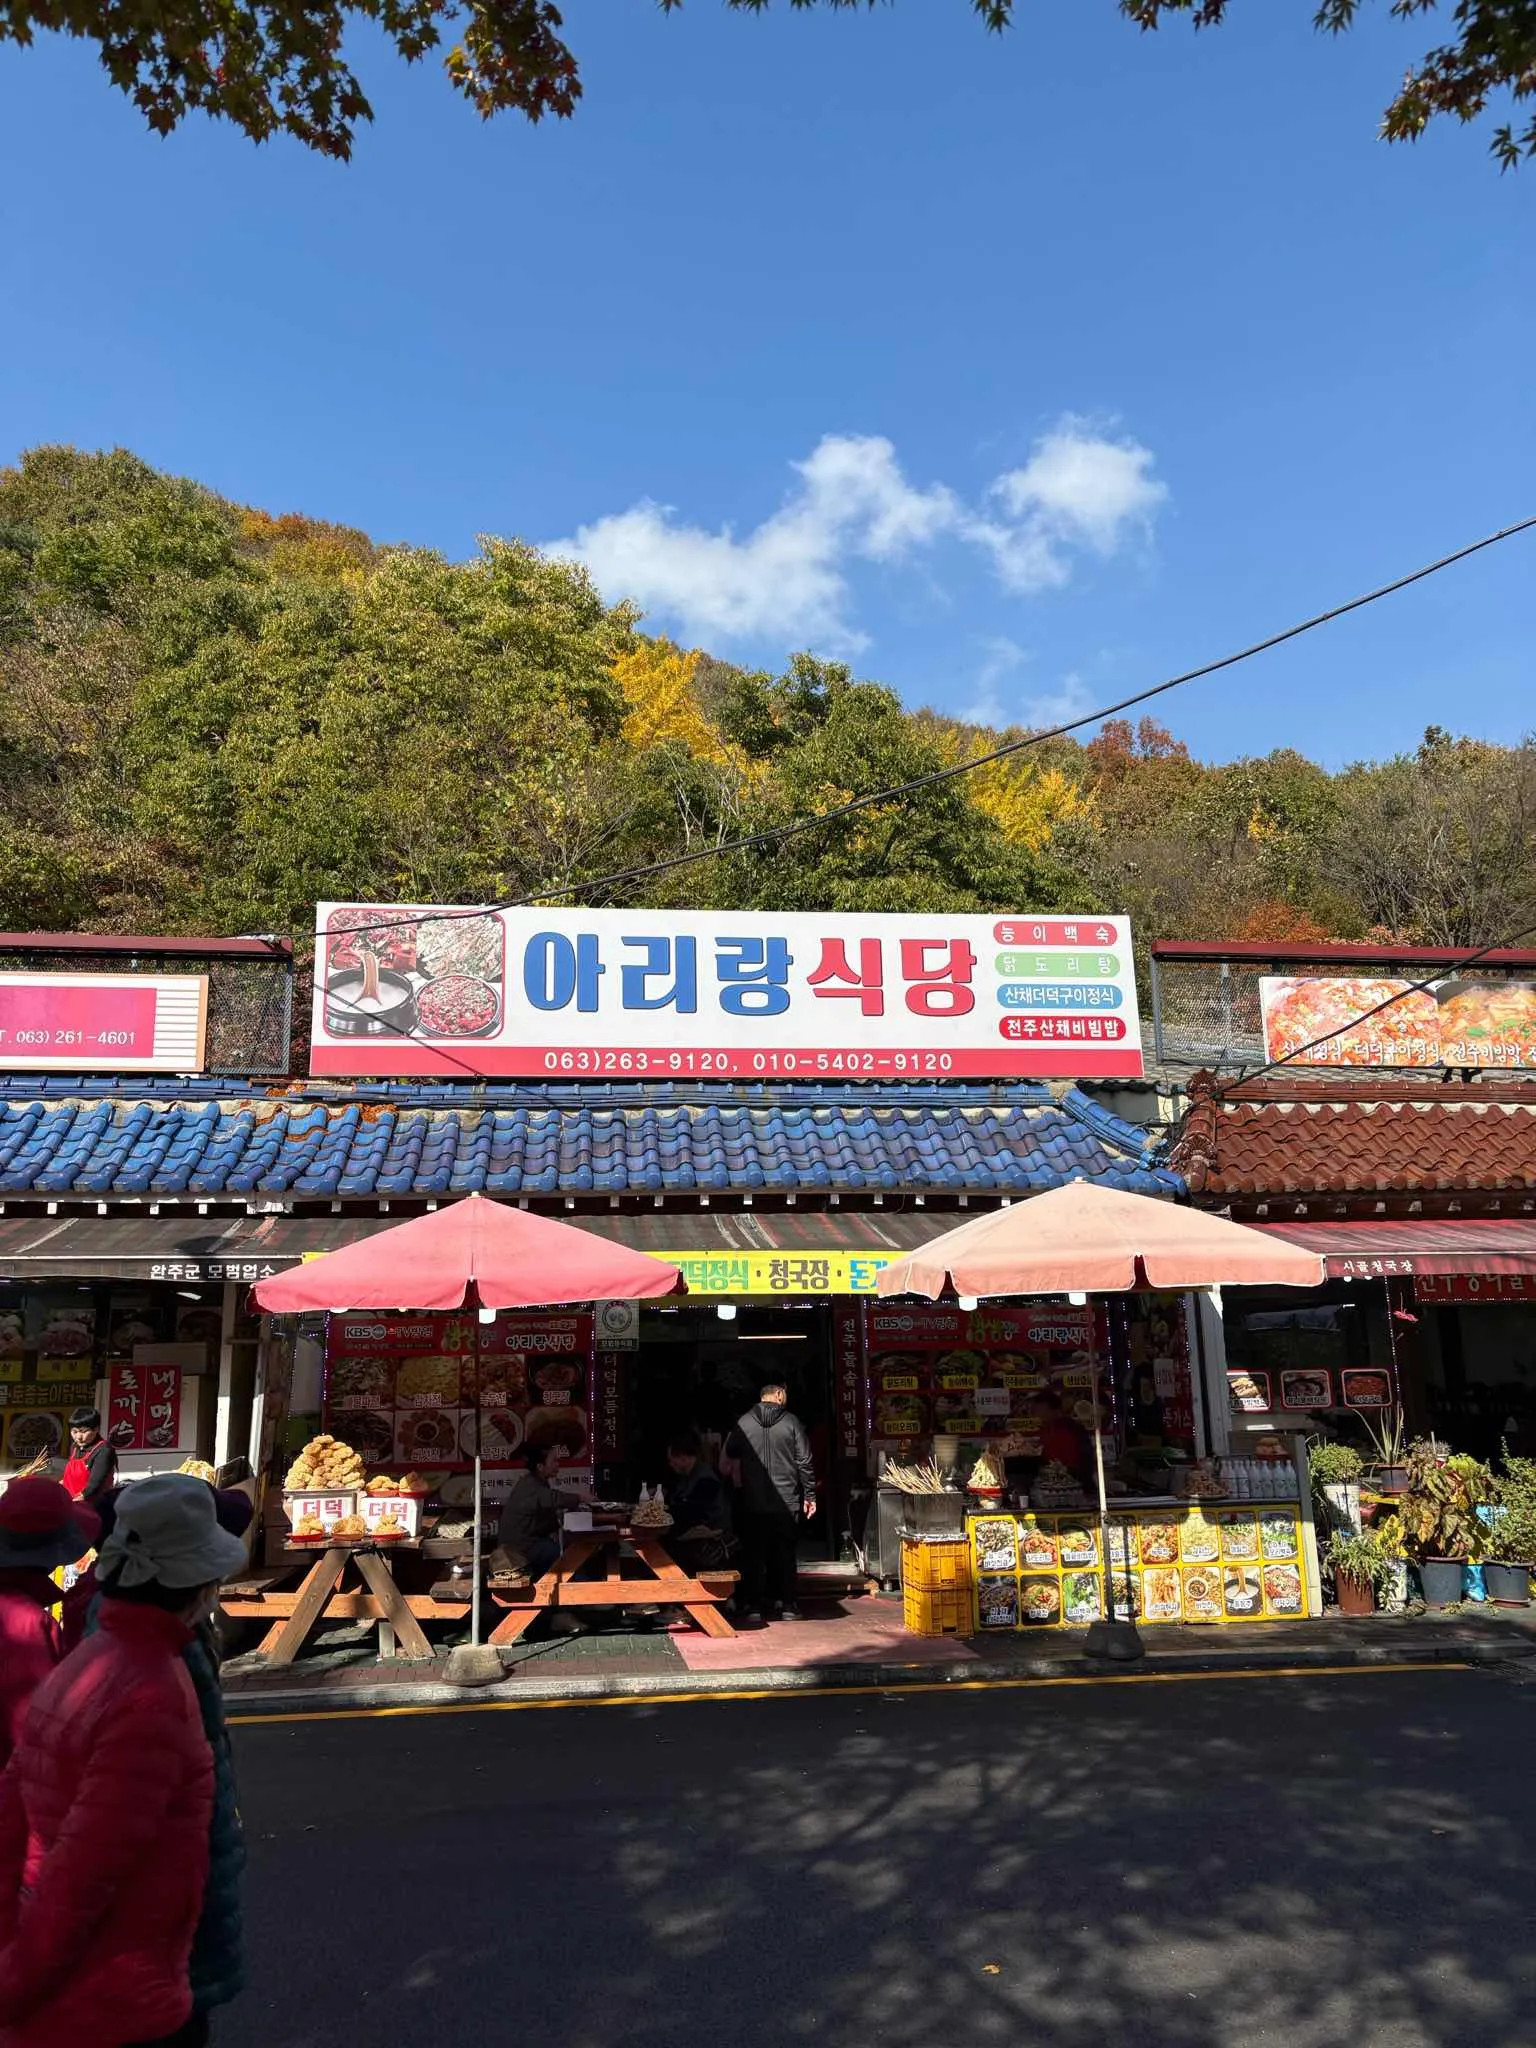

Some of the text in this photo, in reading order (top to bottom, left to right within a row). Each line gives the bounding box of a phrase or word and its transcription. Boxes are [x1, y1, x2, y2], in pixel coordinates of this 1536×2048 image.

[523, 931, 977, 1017] 아리랑식당
[1005, 987, 1115, 1006] 산채더덕구이정식
[1007, 1018, 1119, 1038] 전주산채비빔밥
[55, 1031, 135, 1045] 261-4601
[753, 1053, 953, 1072] 010-5402-9120
[151, 1264, 275, 1280] 완주군 모범업소
[769, 1259, 830, 1290] 청국장
[850, 1260, 889, 1290] 돈
[345, 1326, 372, 1338] KBS
[875, 1318, 899, 1329] KBS
[506, 1334, 577, 1351] 아리랑식당
[151, 1369, 176, 1429] 냉면
[303, 1499, 343, 1519] 더덕
[369, 1502, 408, 1521] 더덕
